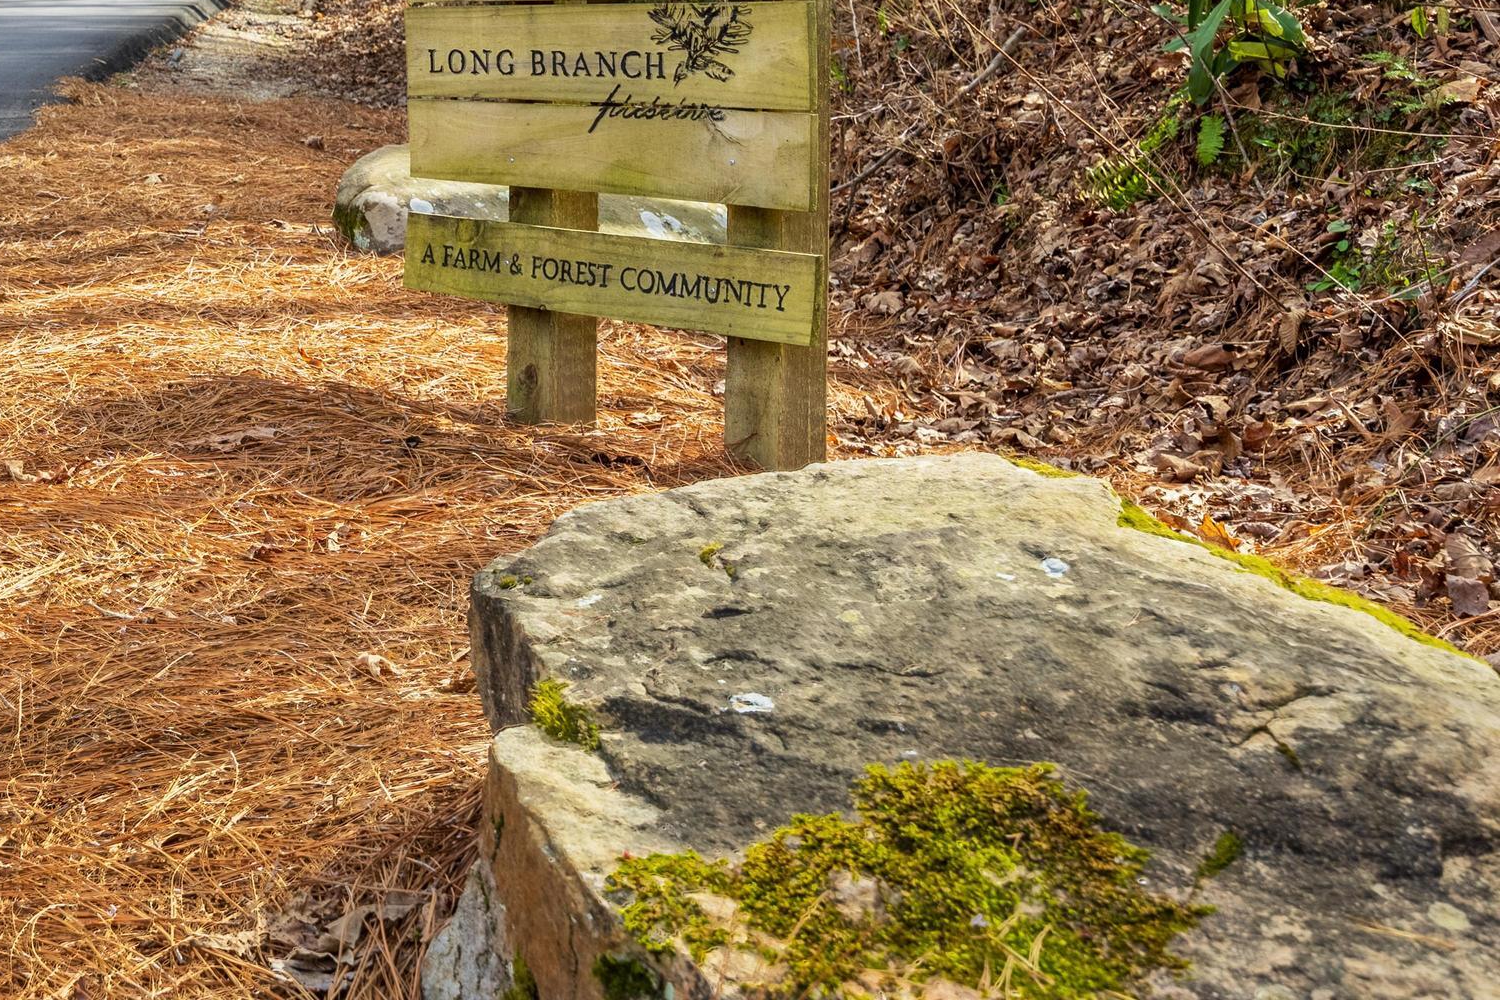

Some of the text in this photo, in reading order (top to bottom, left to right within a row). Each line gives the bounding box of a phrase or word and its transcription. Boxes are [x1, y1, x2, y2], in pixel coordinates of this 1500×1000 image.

[429, 49, 667, 79] LONG BRANCH
[421, 243, 791, 312] A FARM & FOREST COMMUNITY
